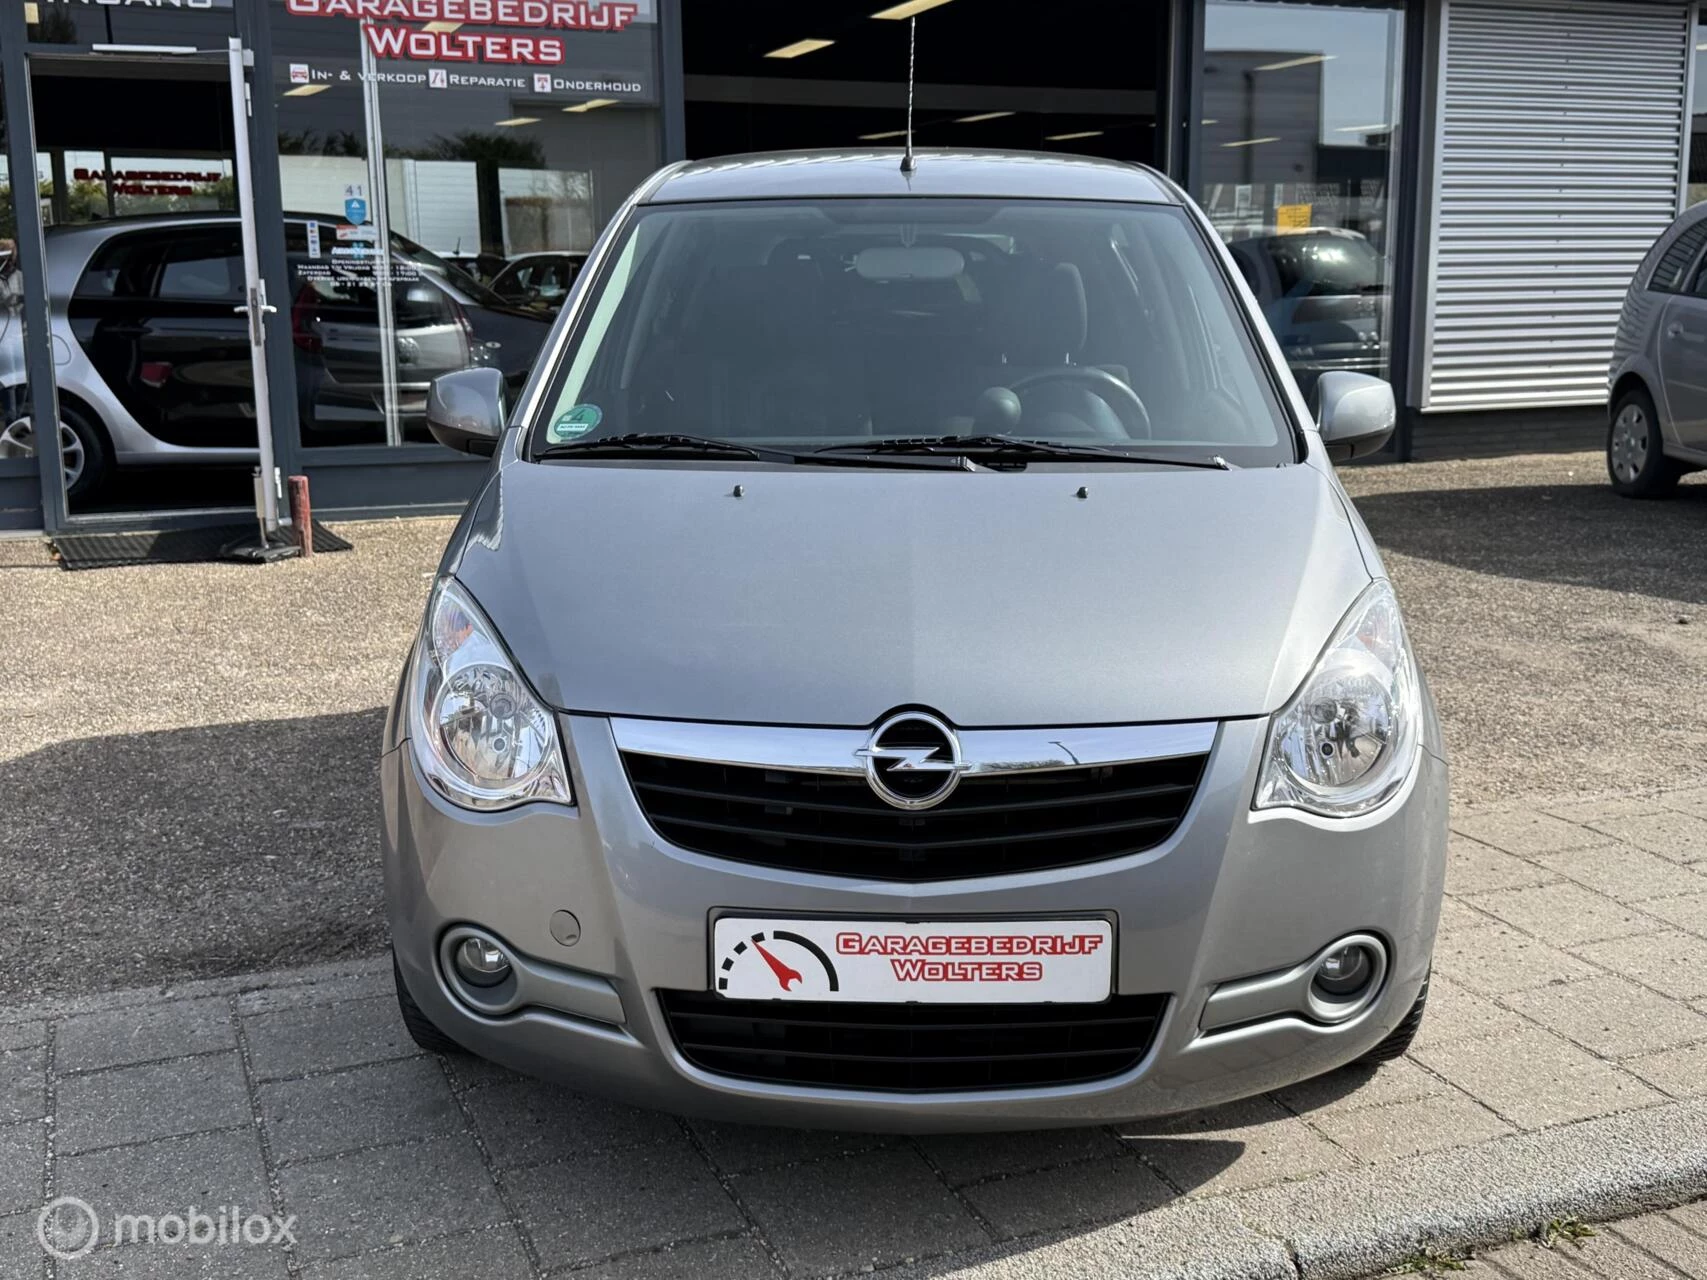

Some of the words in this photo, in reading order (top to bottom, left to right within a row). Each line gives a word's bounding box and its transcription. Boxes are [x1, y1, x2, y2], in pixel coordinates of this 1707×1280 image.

[364, 24, 564, 63] WOLTERS
[311, 69, 333, 80] IN-
[340, 70, 351, 81] &
[358, 71, 427, 83] VERKOOP
[450, 74, 526, 88] REPARATIE
[553, 78, 642, 92] ONDERHOUD
[836, 932, 1104, 956] GARAGEBEDRIJF
[890, 959, 1043, 982] WOLTERS
